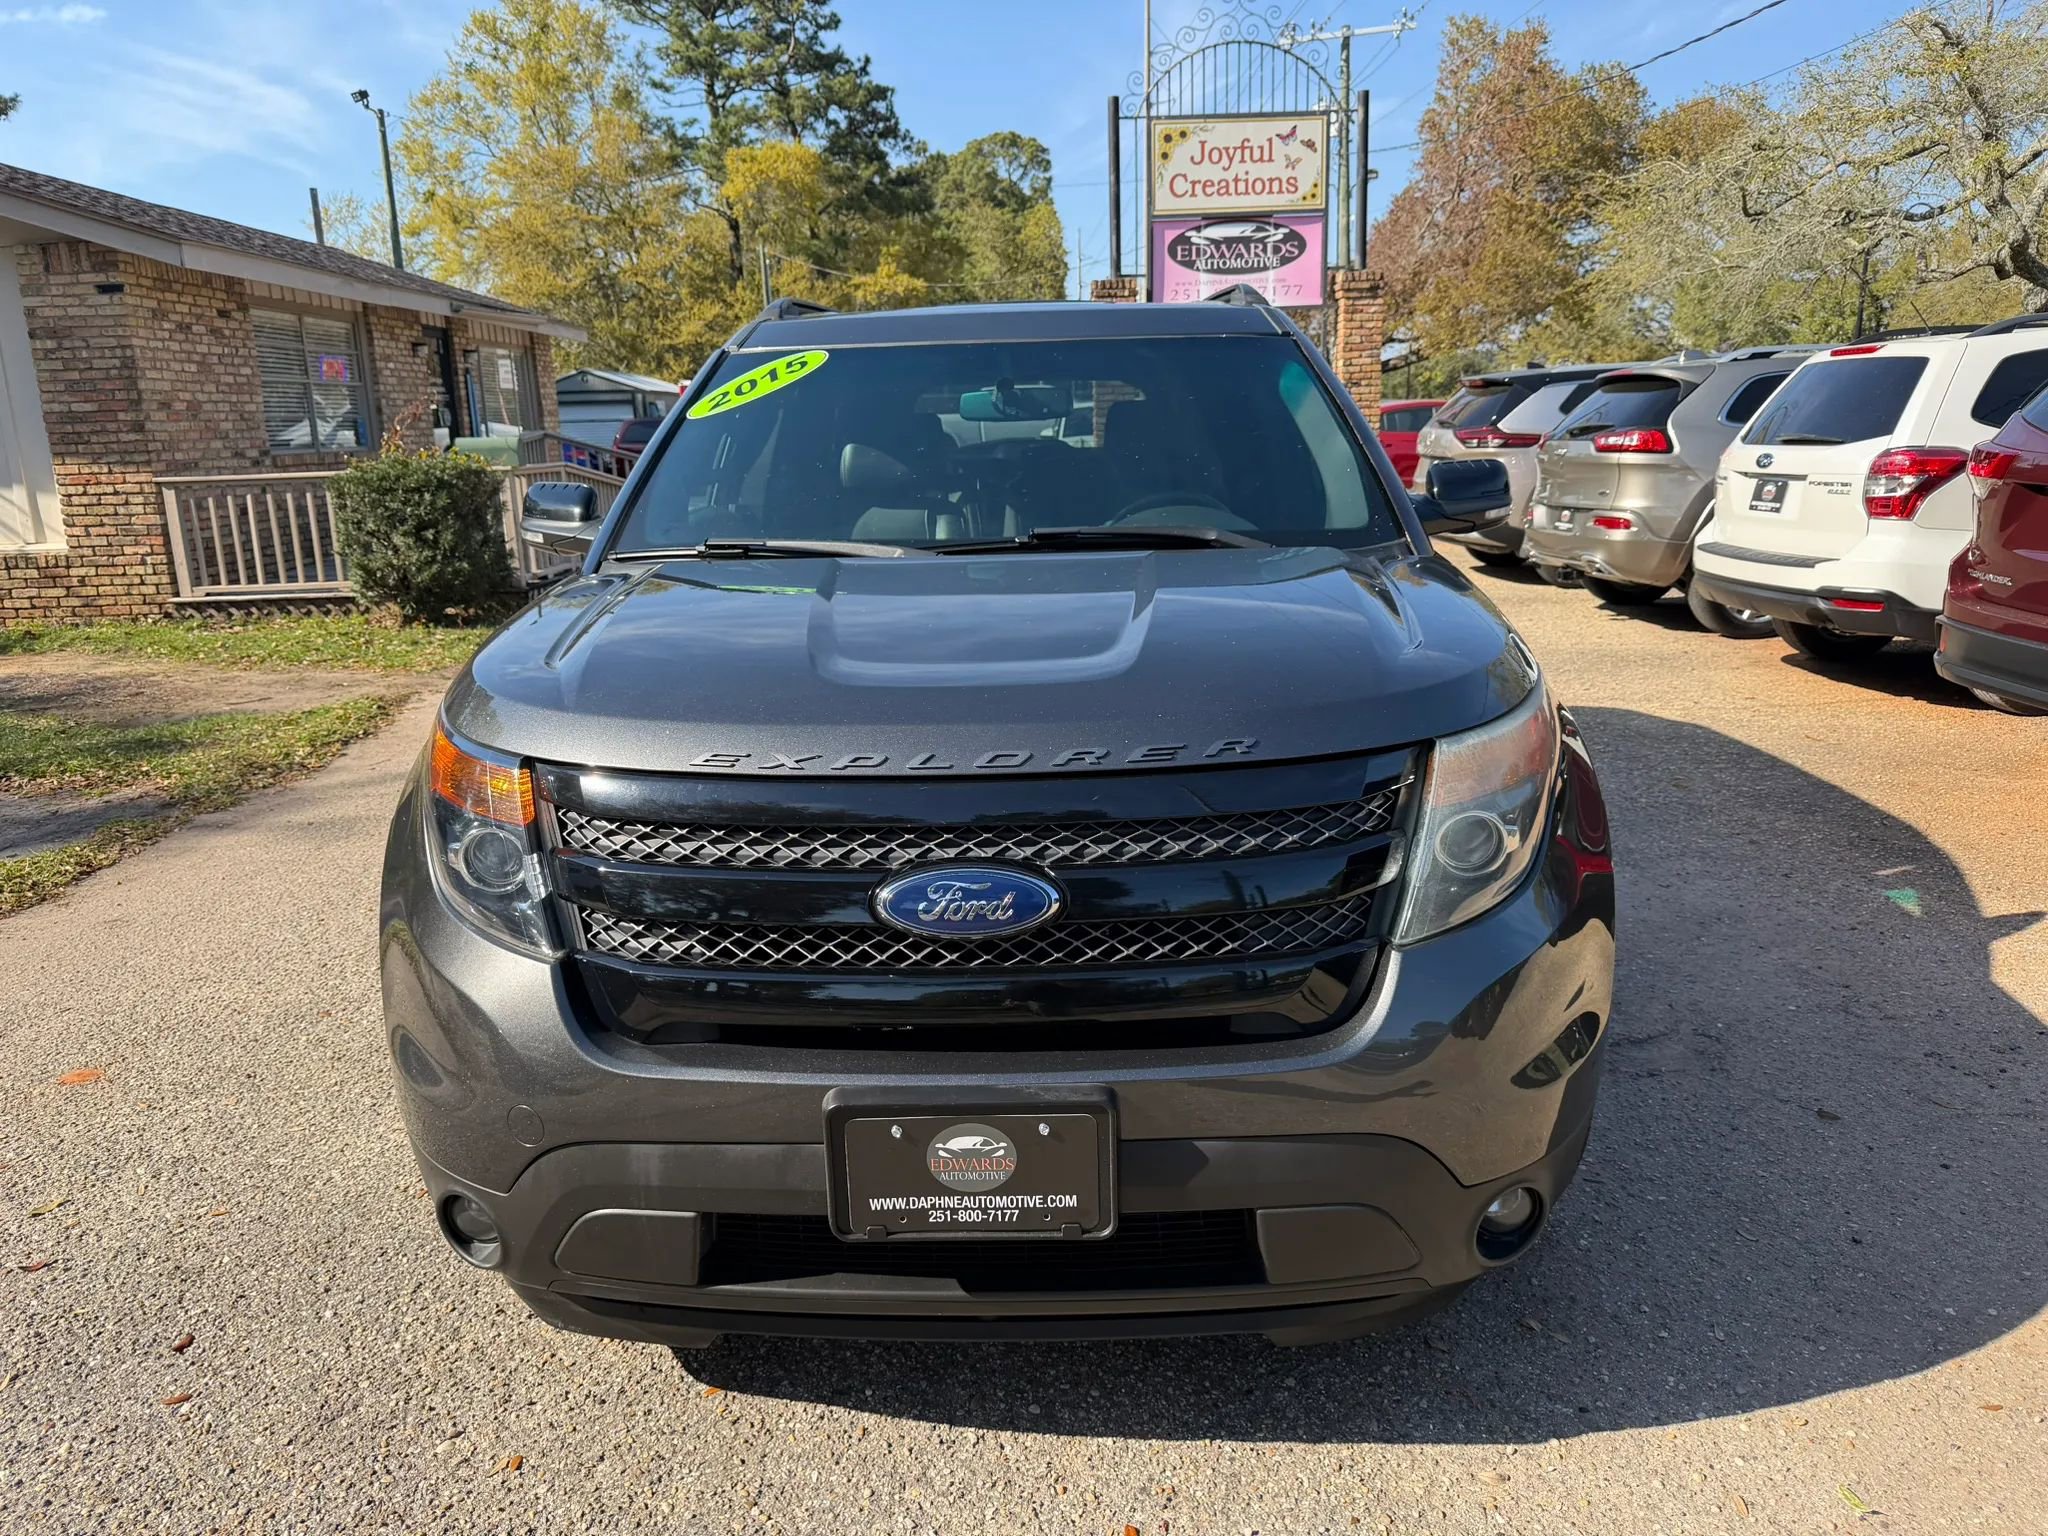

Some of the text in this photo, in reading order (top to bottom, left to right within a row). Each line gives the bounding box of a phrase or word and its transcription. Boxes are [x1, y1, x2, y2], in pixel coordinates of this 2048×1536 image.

[1190, 136, 1275, 171] Joyful
[1169, 171, 1300, 198] Creations
[1176, 241, 1300, 261] EDWARDS
[1193, 255, 1281, 271] AUTOMOTIVE
[707, 355, 809, 413] 2015
[688, 736, 1261, 771] EXPLORER
[917, 880, 1016, 922] Ford
[930, 1157, 1015, 1171] EDWARDS
[939, 1172, 1006, 1181] AUTOMOTIVE
[869, 1195, 1077, 1210] WWW.DAPHNEAUTOMOTIVE.COM
[928, 1210, 1019, 1222] 251-800-7177
